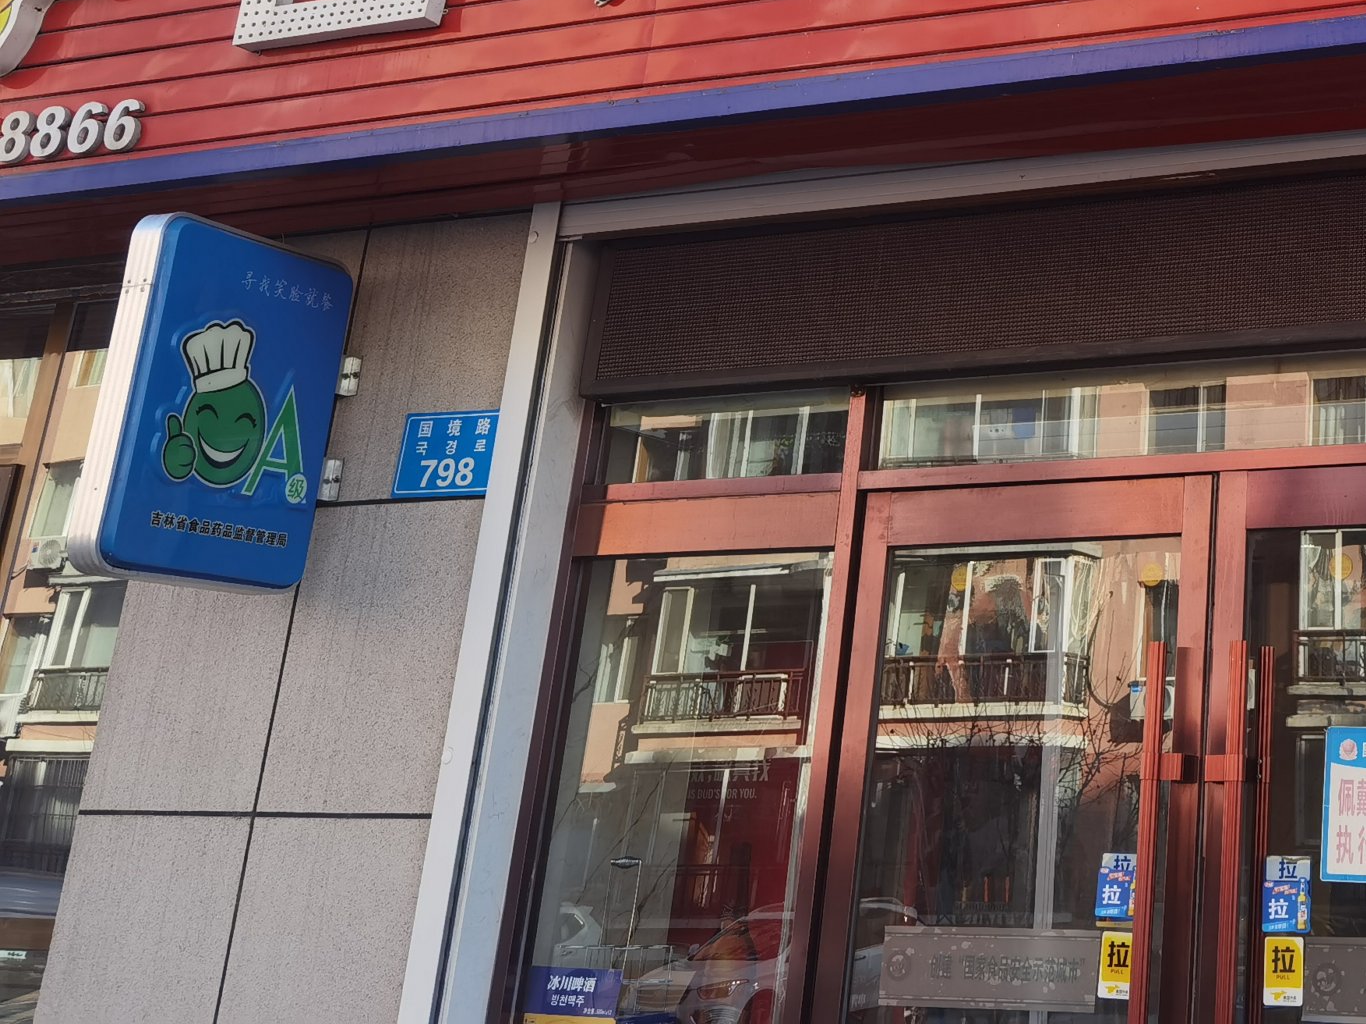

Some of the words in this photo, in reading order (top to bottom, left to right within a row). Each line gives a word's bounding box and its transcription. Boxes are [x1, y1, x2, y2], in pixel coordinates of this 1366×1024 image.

[417, 417, 492, 438] 国境路
[415, 438, 487, 456] 국경로
[420, 457, 475, 488] 798
[150, 509, 289, 549] 吉林省食品药品监督管理局
[1102, 884, 1121, 905] 拉
[1268, 898, 1289, 920] 拉
[1107, 940, 1130, 968] 拉
[1272, 946, 1295, 974] 拉
[547, 974, 598, 994] 冰川啤酒
